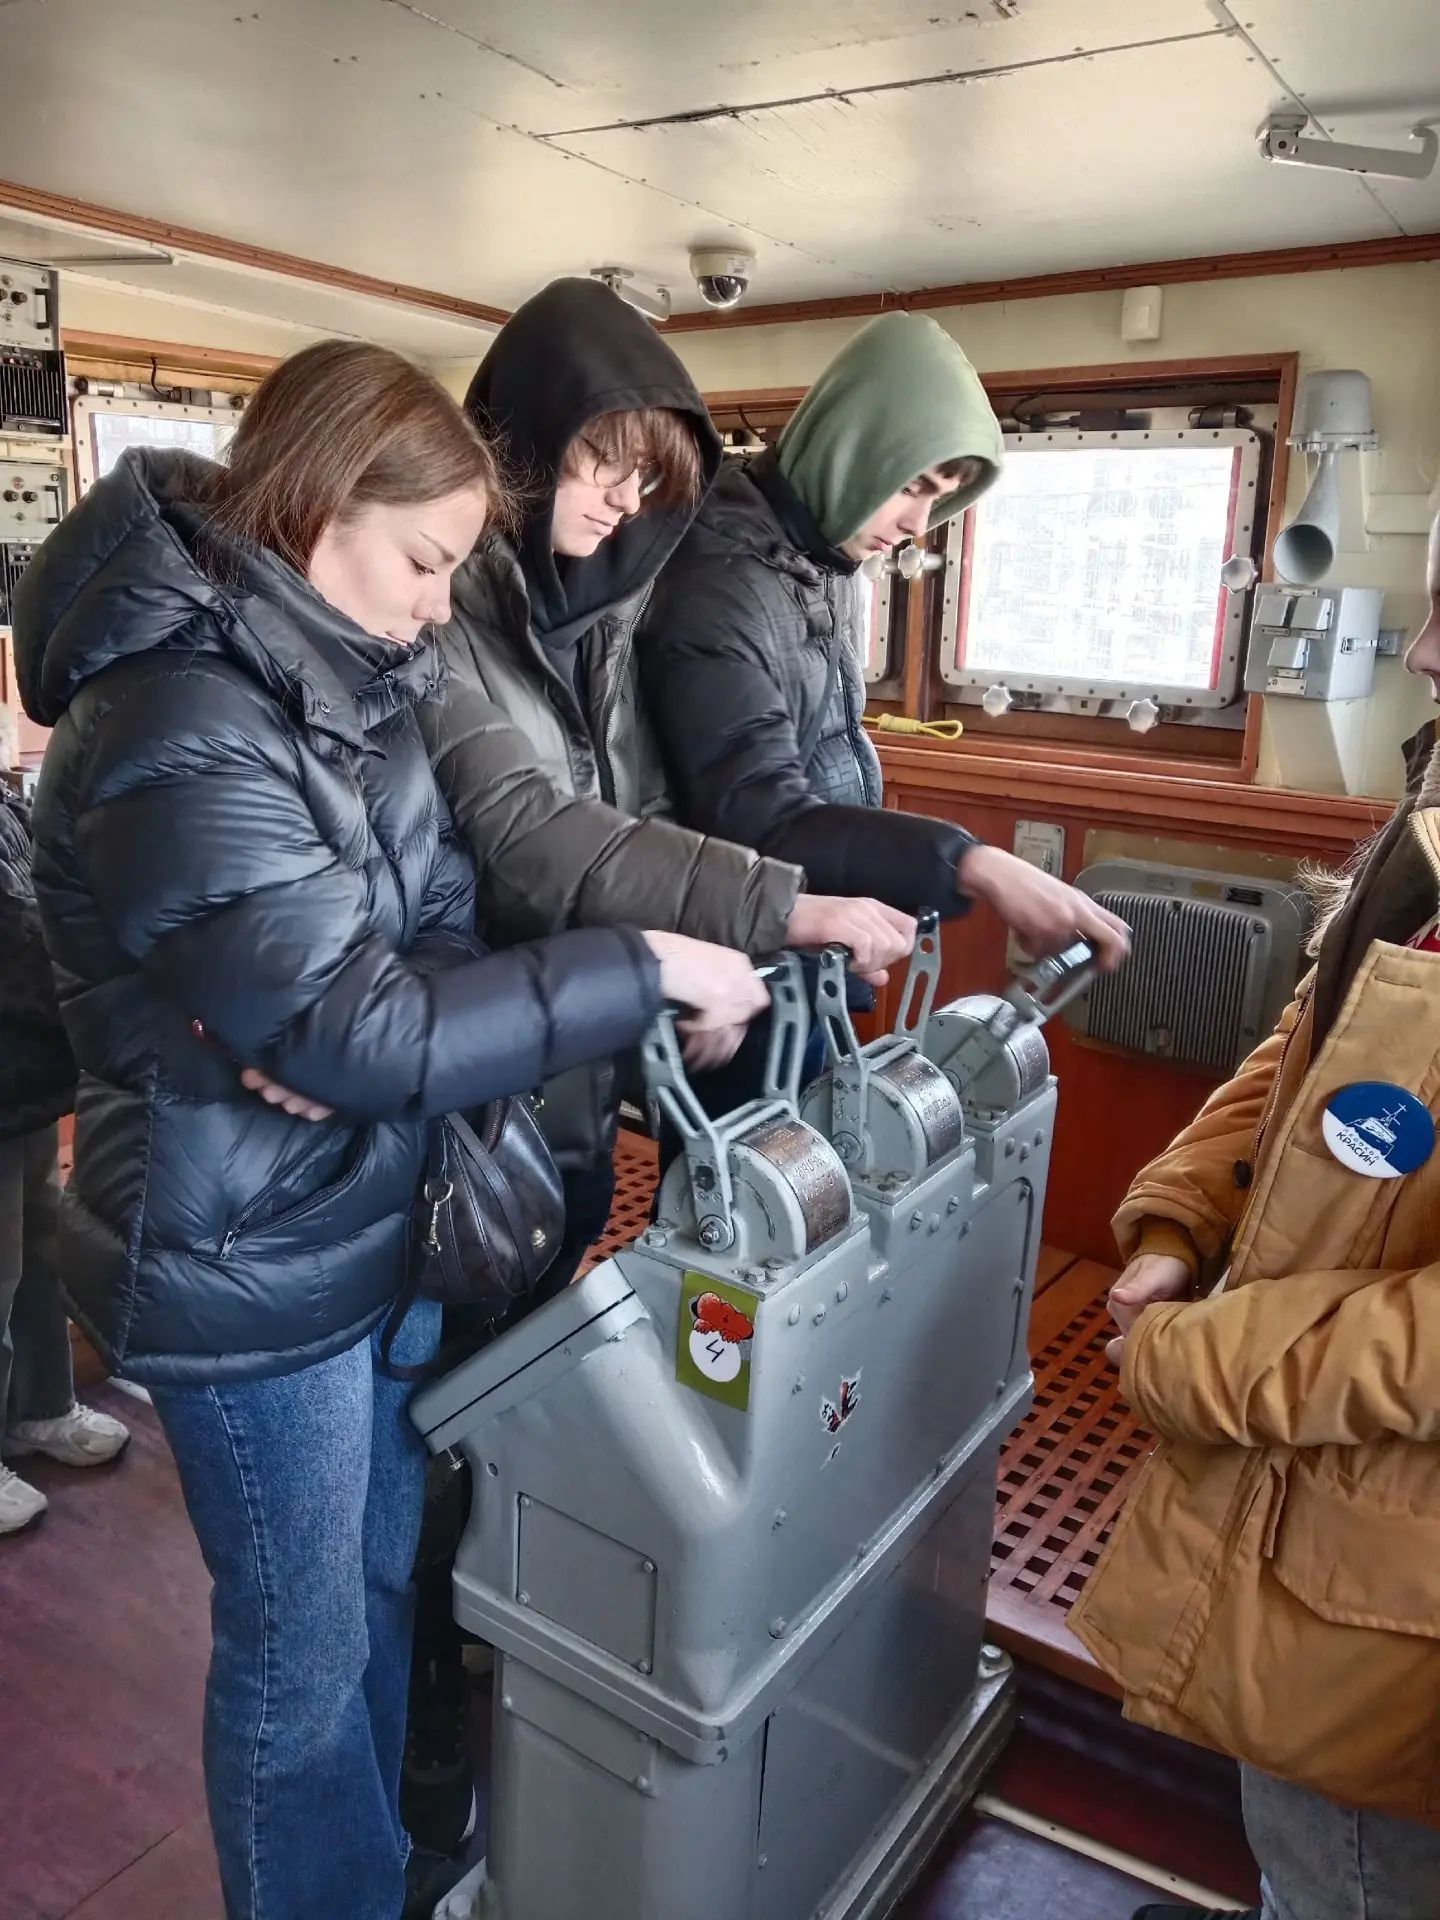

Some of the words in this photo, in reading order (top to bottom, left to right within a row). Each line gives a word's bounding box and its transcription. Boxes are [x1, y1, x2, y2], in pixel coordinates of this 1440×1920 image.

[1336, 1131, 1376, 1166] КРАСИН
[1342, 1128, 1380, 1161] ЛЕДОКОЛ
[705, 1338, 725, 1364] 4
